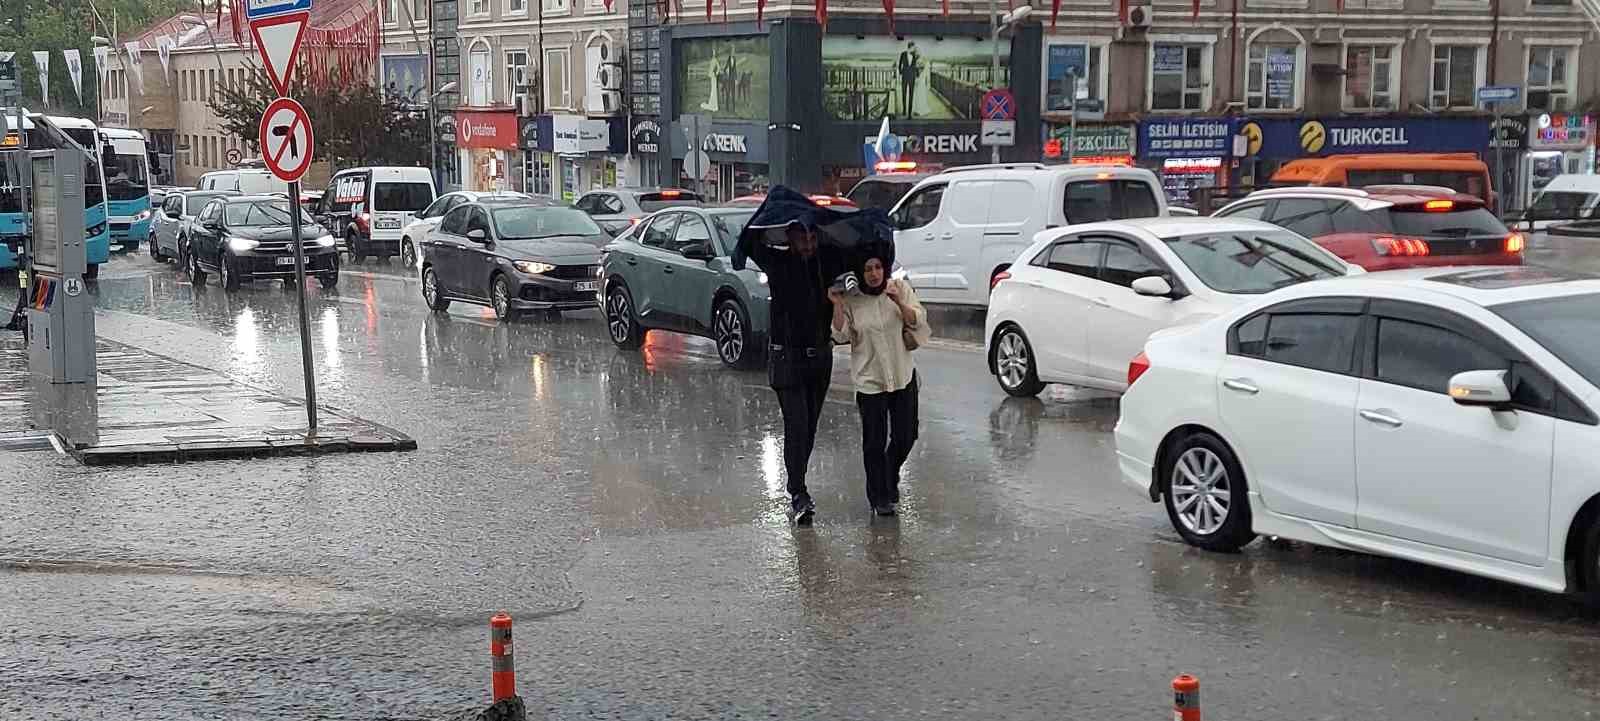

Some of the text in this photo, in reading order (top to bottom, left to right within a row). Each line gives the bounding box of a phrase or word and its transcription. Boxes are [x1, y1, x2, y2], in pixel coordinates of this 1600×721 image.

[1150, 120, 1228, 138] SELİN İLETİŞİM
[1330, 127, 1408, 146] TURKCELL
[923, 135, 978, 152] RENK
